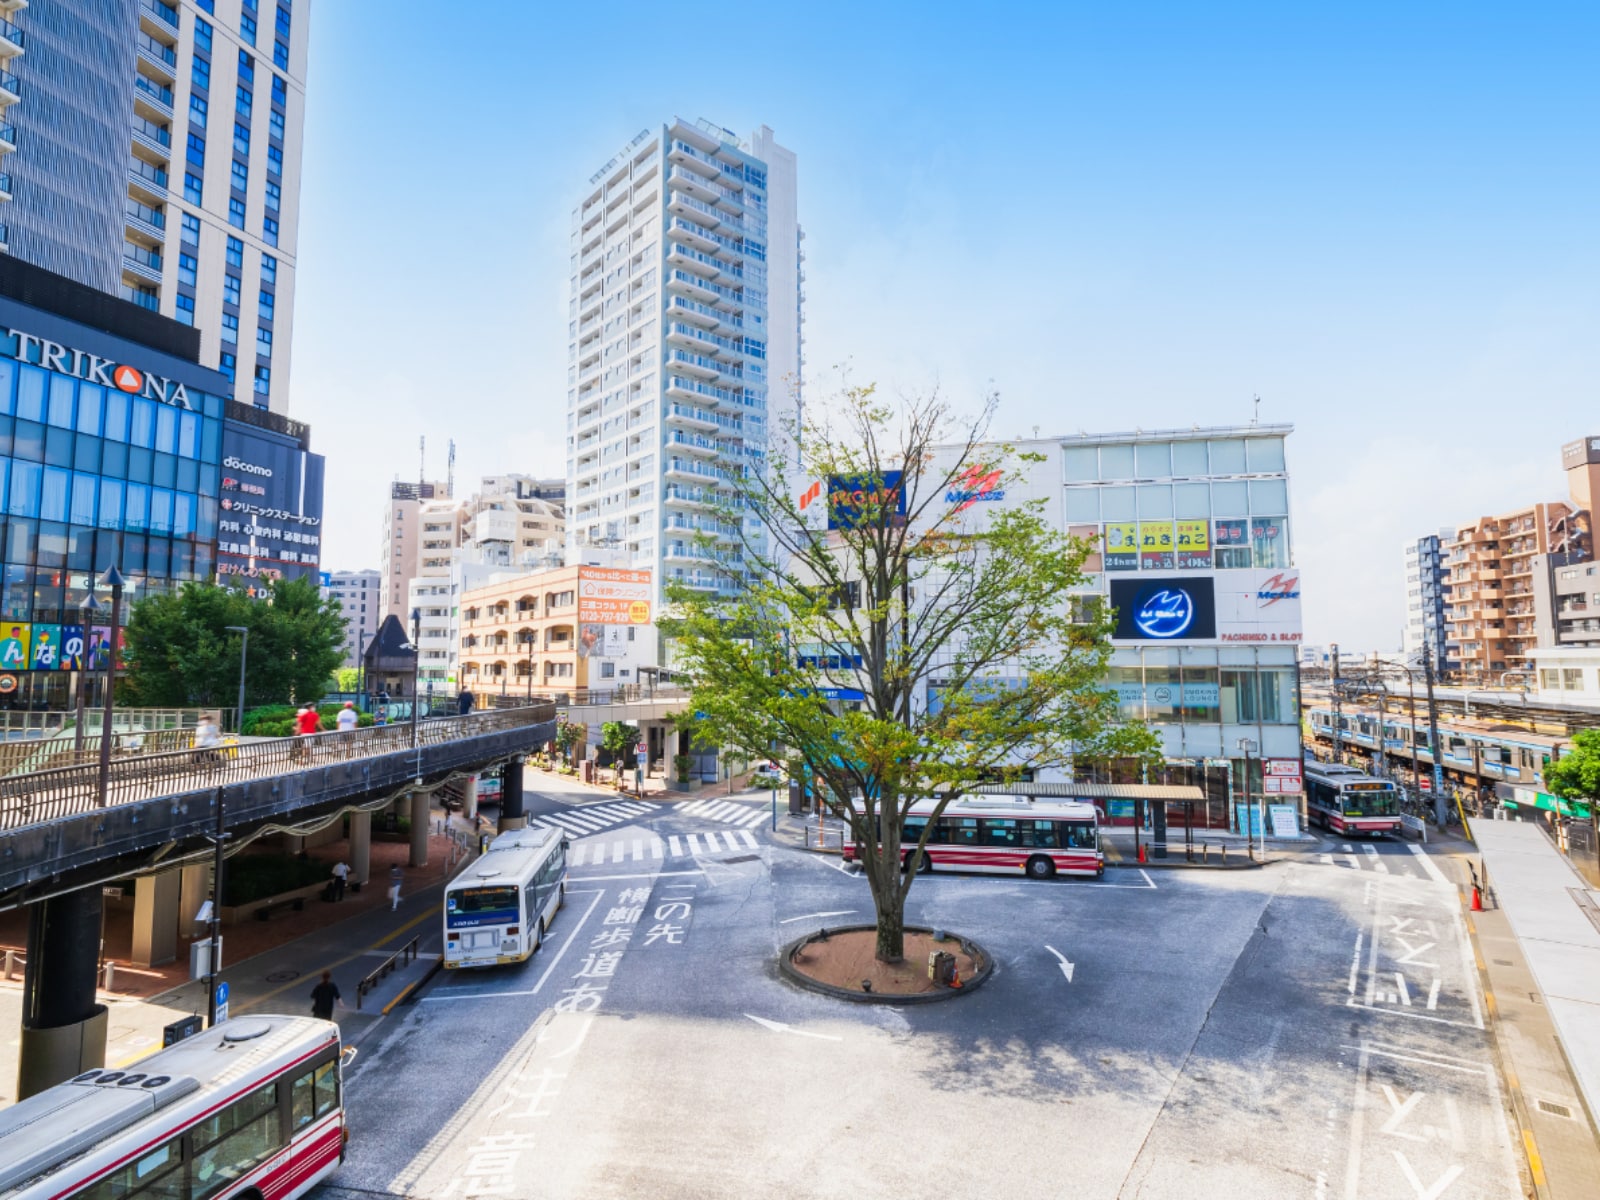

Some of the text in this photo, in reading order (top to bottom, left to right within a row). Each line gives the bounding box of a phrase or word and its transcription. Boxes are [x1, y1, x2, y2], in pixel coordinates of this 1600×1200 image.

[223, 456, 273, 477] docomo
[233, 501, 320, 526] クリニックステーション
[219, 519, 240, 534] 内科
[1124, 533, 1206, 547] まねきねこ
[1221, 633, 1303, 641] PACHINKO & SLOT
